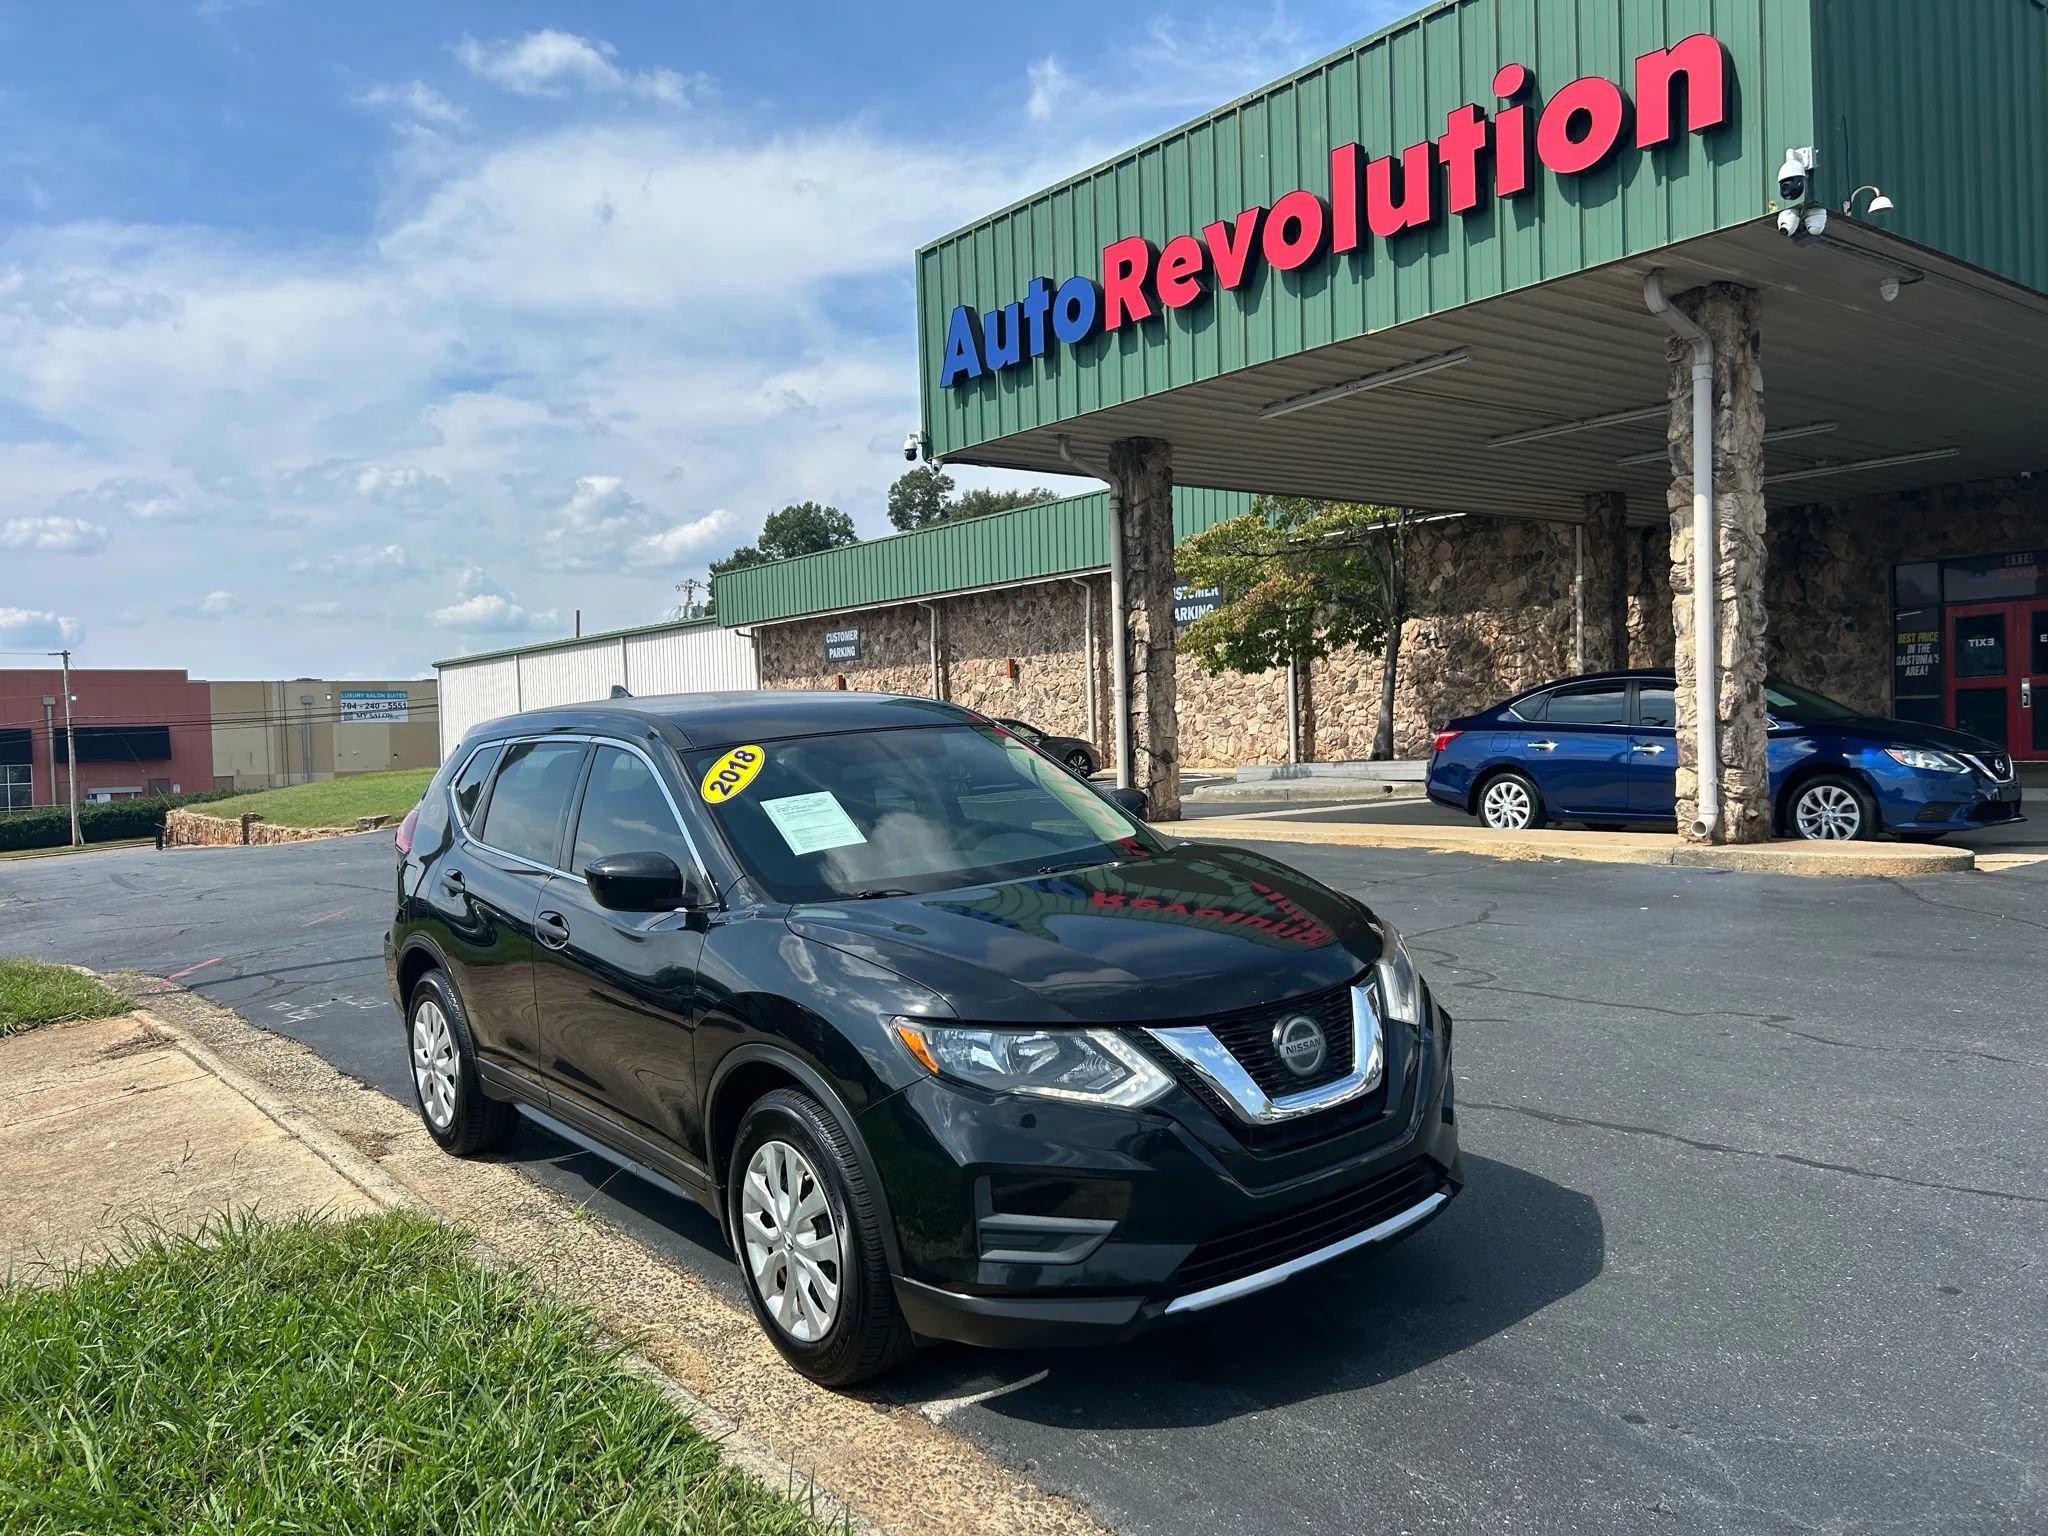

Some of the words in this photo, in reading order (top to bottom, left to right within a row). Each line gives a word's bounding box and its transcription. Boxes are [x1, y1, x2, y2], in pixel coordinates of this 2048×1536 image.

[1174, 604, 1214, 621] ARKING
[826, 630, 858, 643] CUSTOMER
[1897, 632, 1916, 644] BEST
[1917, 631, 1938, 643] PRICE
[829, 646, 856, 659] PARKING
[1907, 643, 1916, 654] IN
[1917, 642, 1931, 653] THE
[1905, 665, 1929, 677] AREA!
[709, 750, 756, 796] 2018
[1285, 1037, 1321, 1055] NISSAN
